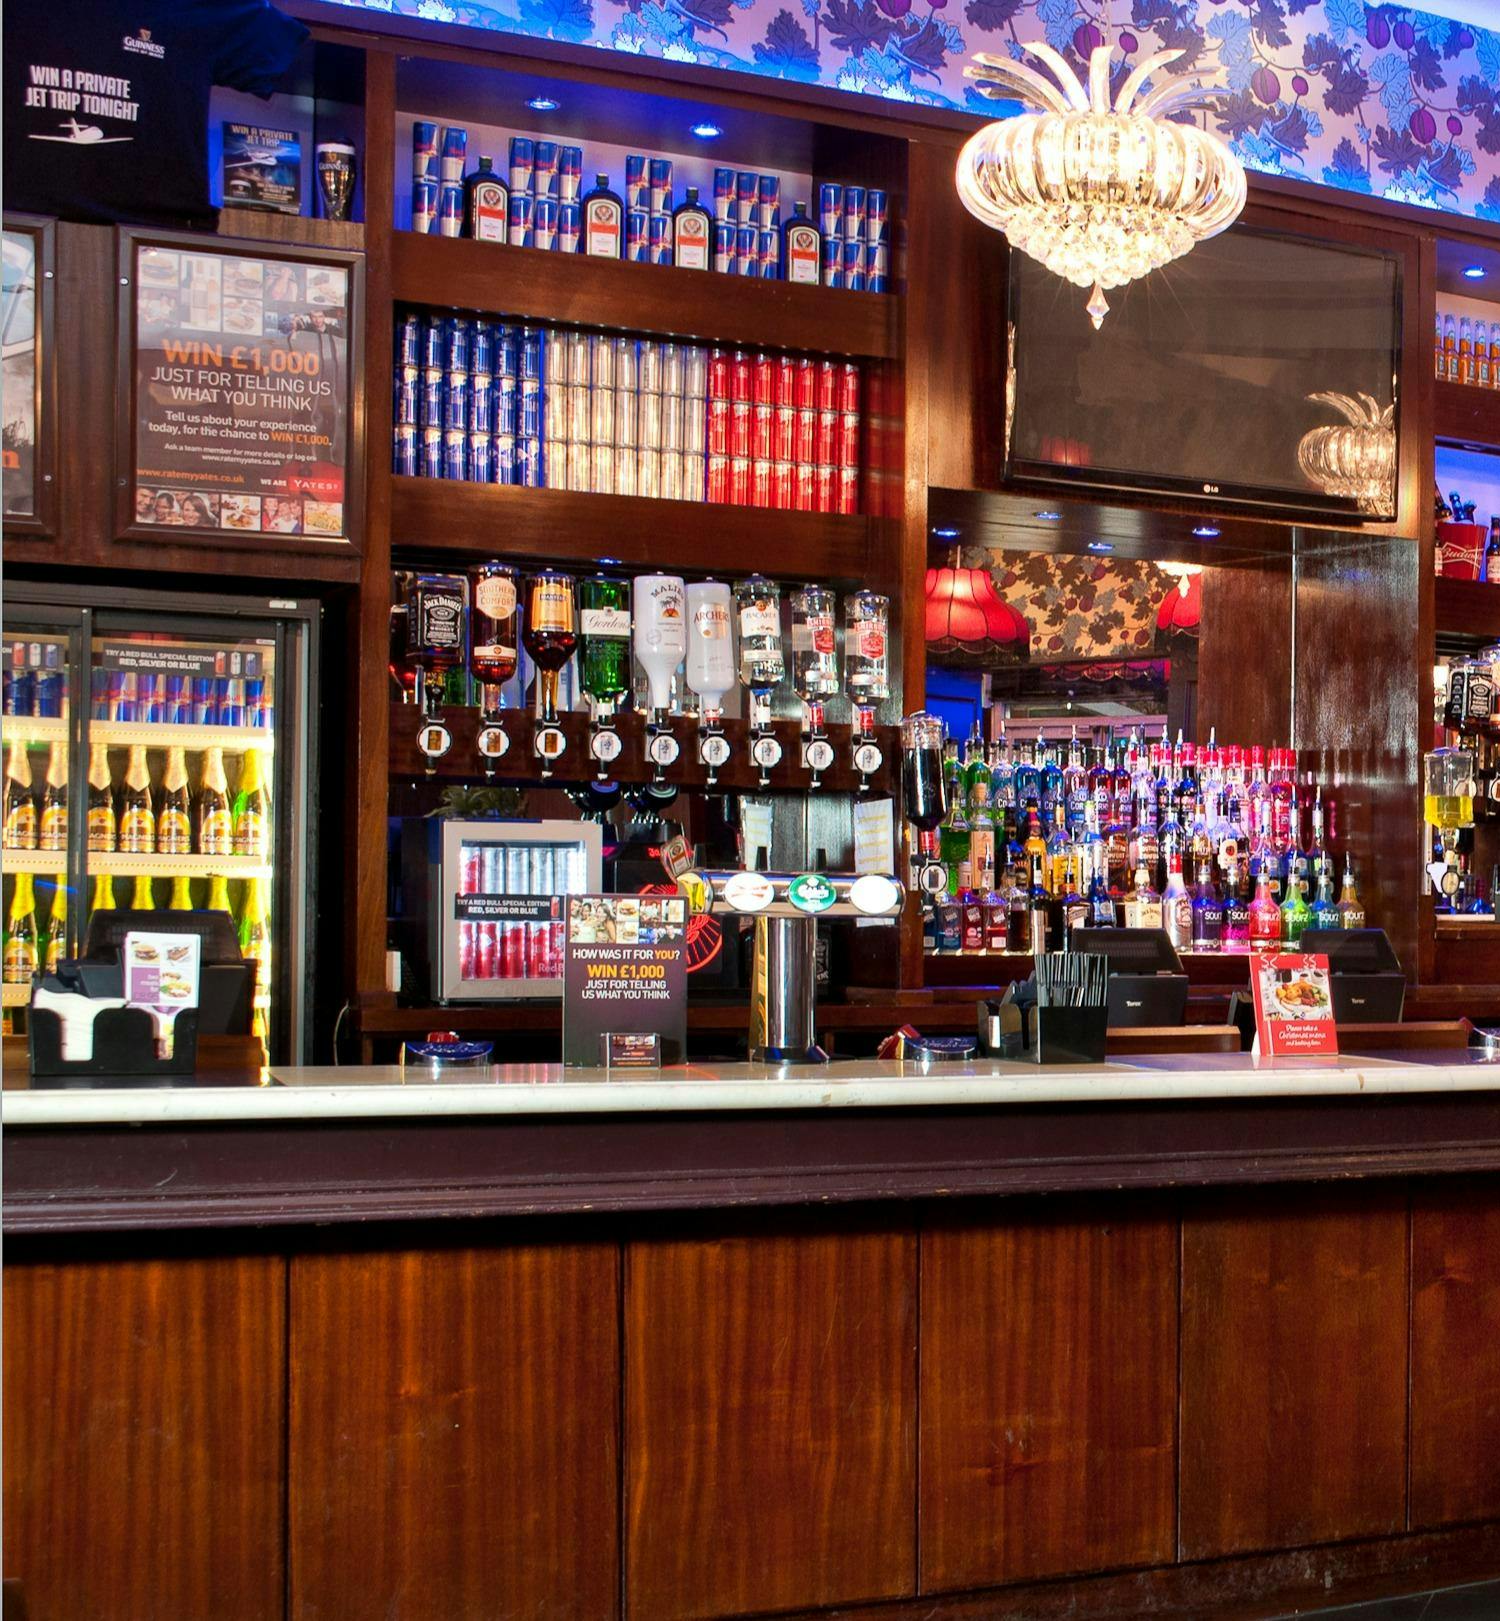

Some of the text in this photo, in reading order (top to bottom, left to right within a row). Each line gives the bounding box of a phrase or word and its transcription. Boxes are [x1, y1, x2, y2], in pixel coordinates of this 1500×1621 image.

[123, 36, 165, 54] GUINNESS
[30, 65, 130, 99] WIN A PRIVATE
[25, 87, 139, 121] JET TRIP TONIGHT
[231, 125, 249, 135] WIN
[259, 128, 294, 141] PRIVATE
[161, 338, 320, 376] WIN £1,000
[151, 366, 331, 396] JUST FOR TELLING US
[171, 385, 313, 412] WHAT YOU THINK
[165, 410, 317, 435] Tell us about your experience
[183, 423, 199, 435] for
[200, 426, 218, 436] the
[219, 427, 257, 440] chance
[259, 430, 269, 441] to
[270, 432, 293, 443] WIN
[105, 649, 119, 657] TRY
[125, 650, 140, 658] RED
[141, 651, 158, 660] BULL
[158, 652, 187, 661] SPECIAL
[188, 654, 215, 662] EDITION
[118, 657, 201, 670] RED, SILVER OR BLUE
[468, 906, 538, 915] RED, SILVER OR BLUE
[474, 899, 487, 907] RED
[572, 949, 680, 961] HOW WAS IT FOR YOU?
[587, 964, 665, 980] WIN £1,000
[585, 980, 666, 989] JUST FOR TELLING
[582, 990, 670, 1000] US WHAT YOU THINK
